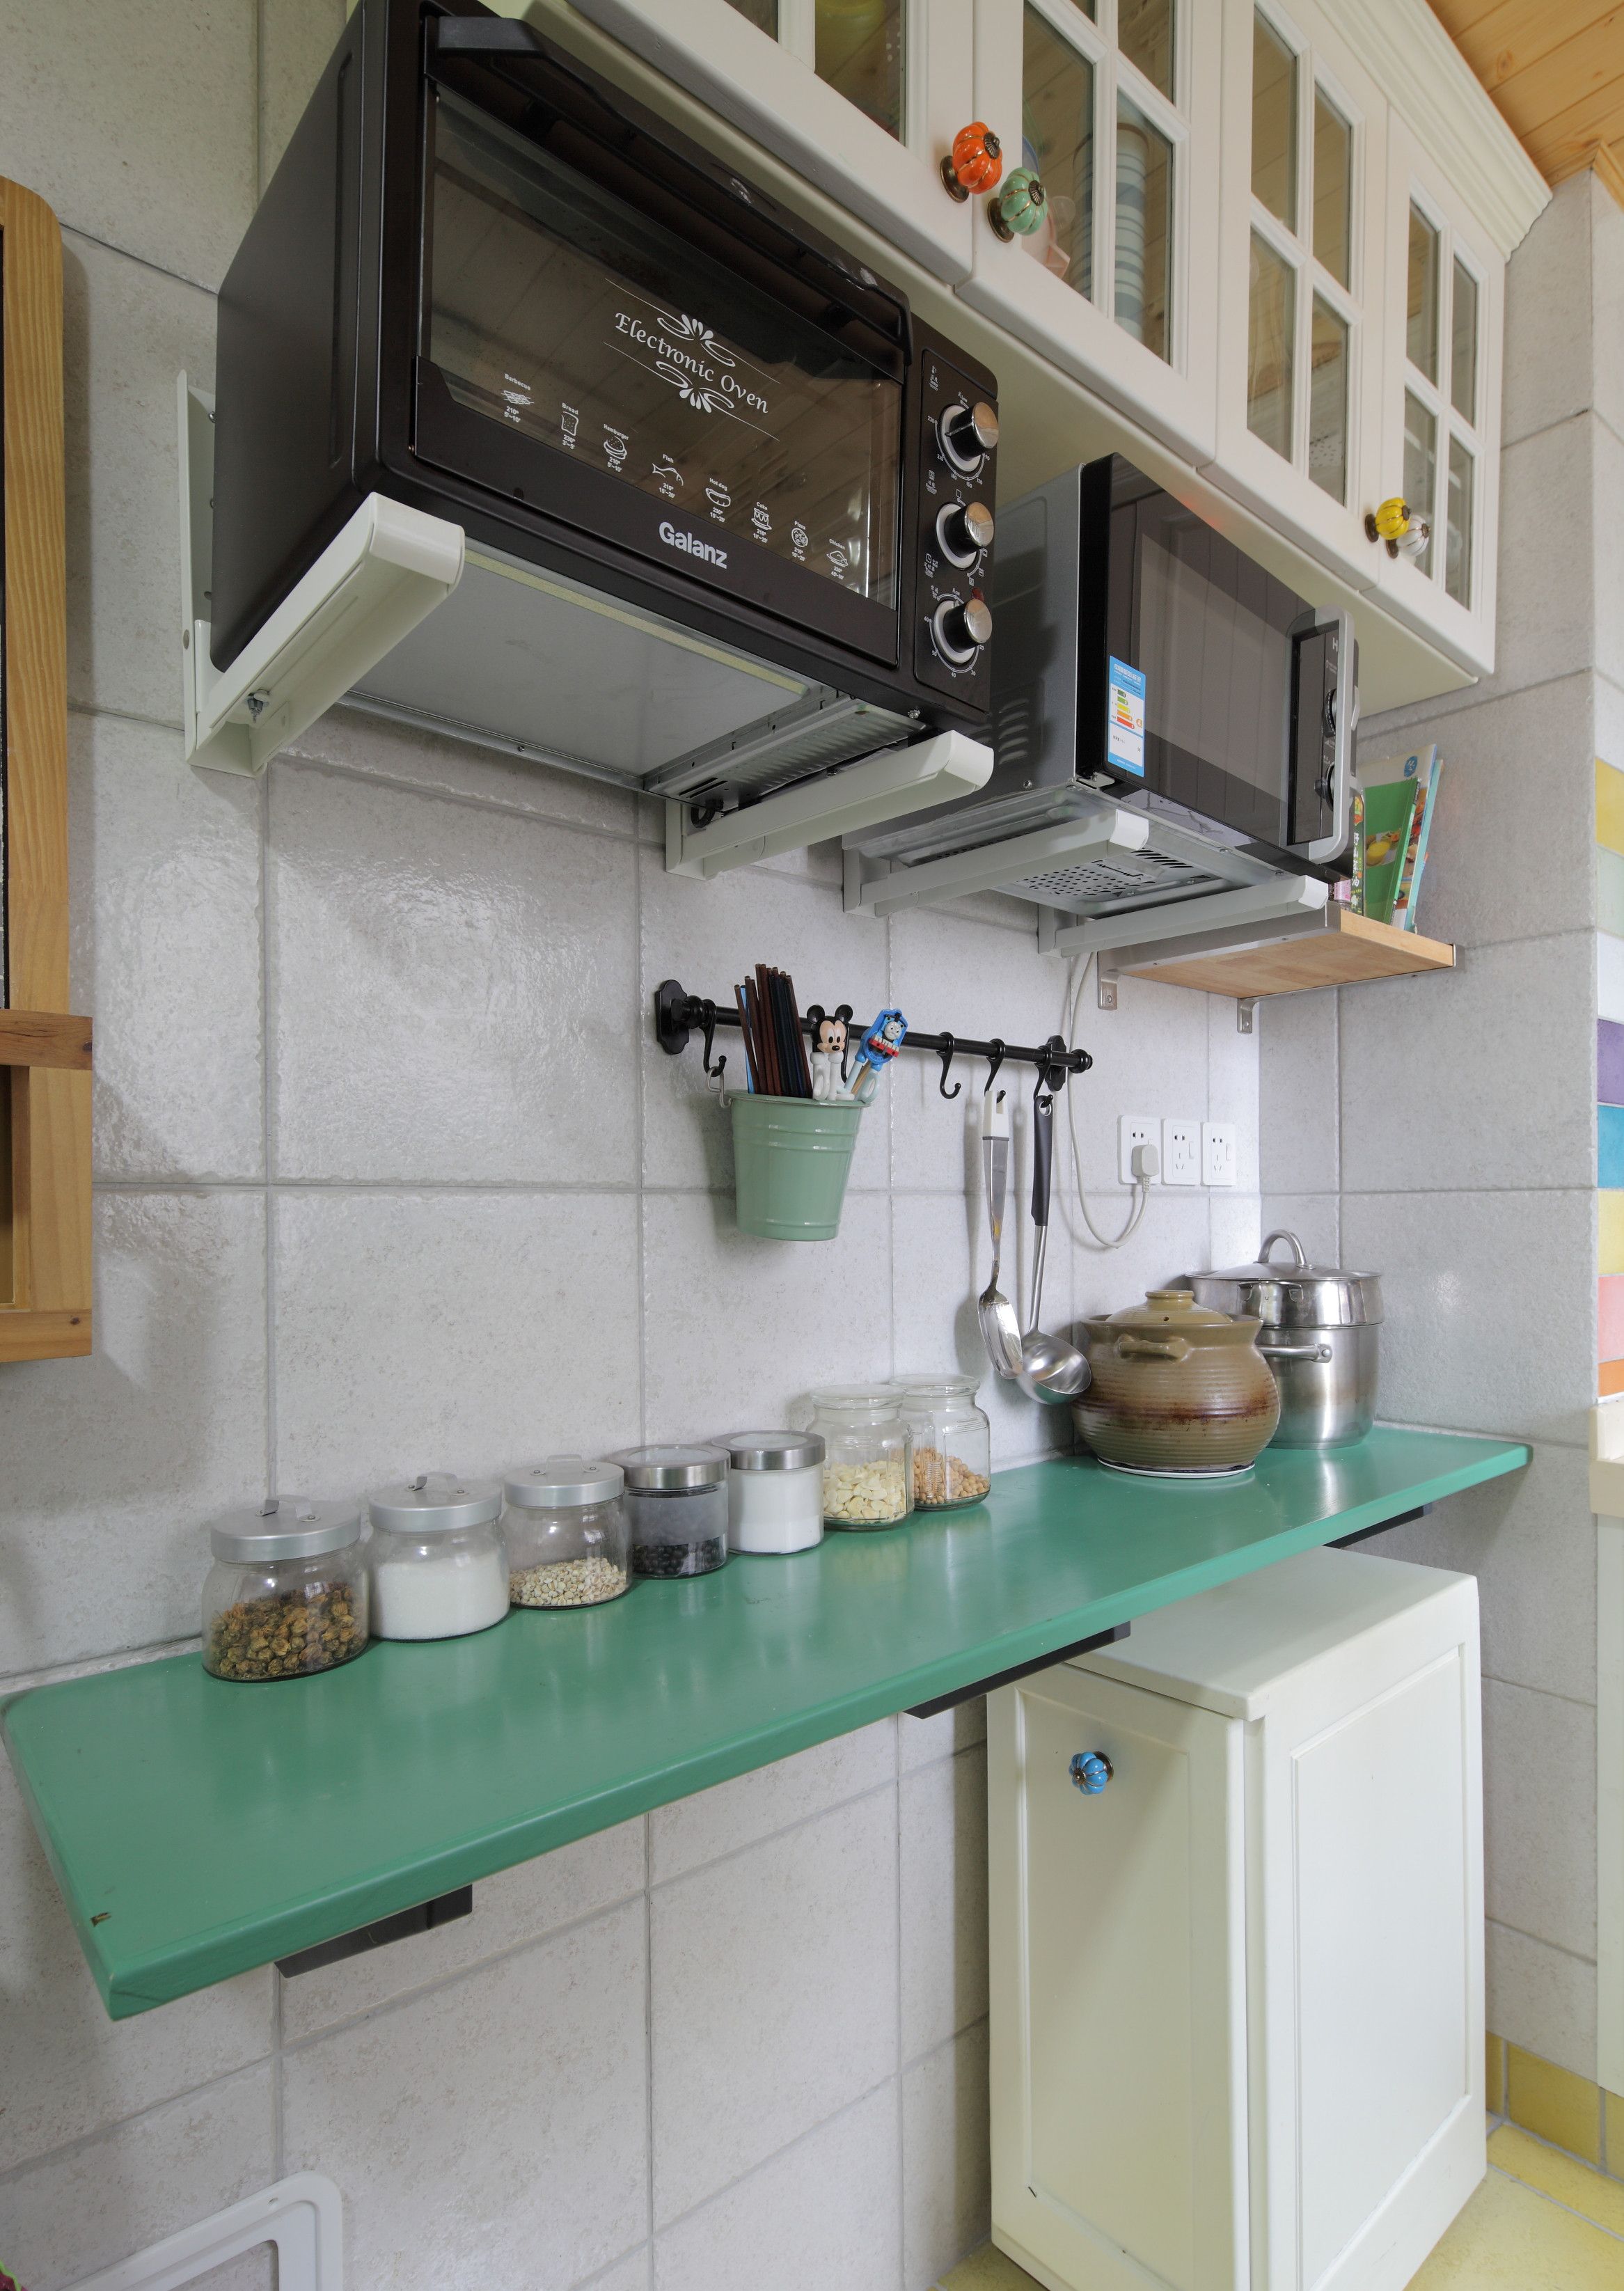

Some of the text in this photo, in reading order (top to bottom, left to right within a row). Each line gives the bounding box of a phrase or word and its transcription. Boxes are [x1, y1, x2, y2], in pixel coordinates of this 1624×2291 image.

[615, 311, 768, 414] Electronic Oven
[505, 373, 531, 391] Barbecue
[562, 402, 579, 415] Bread
[604, 423, 629, 441] Hamburger
[663, 454, 674, 464] Fish
[709, 478, 727, 491] Hot dog
[756, 501, 768, 511] Cake
[794, 520, 806, 530] Pizza
[659, 521, 728, 569] Galanz
[829, 538, 846, 550] Chicken
